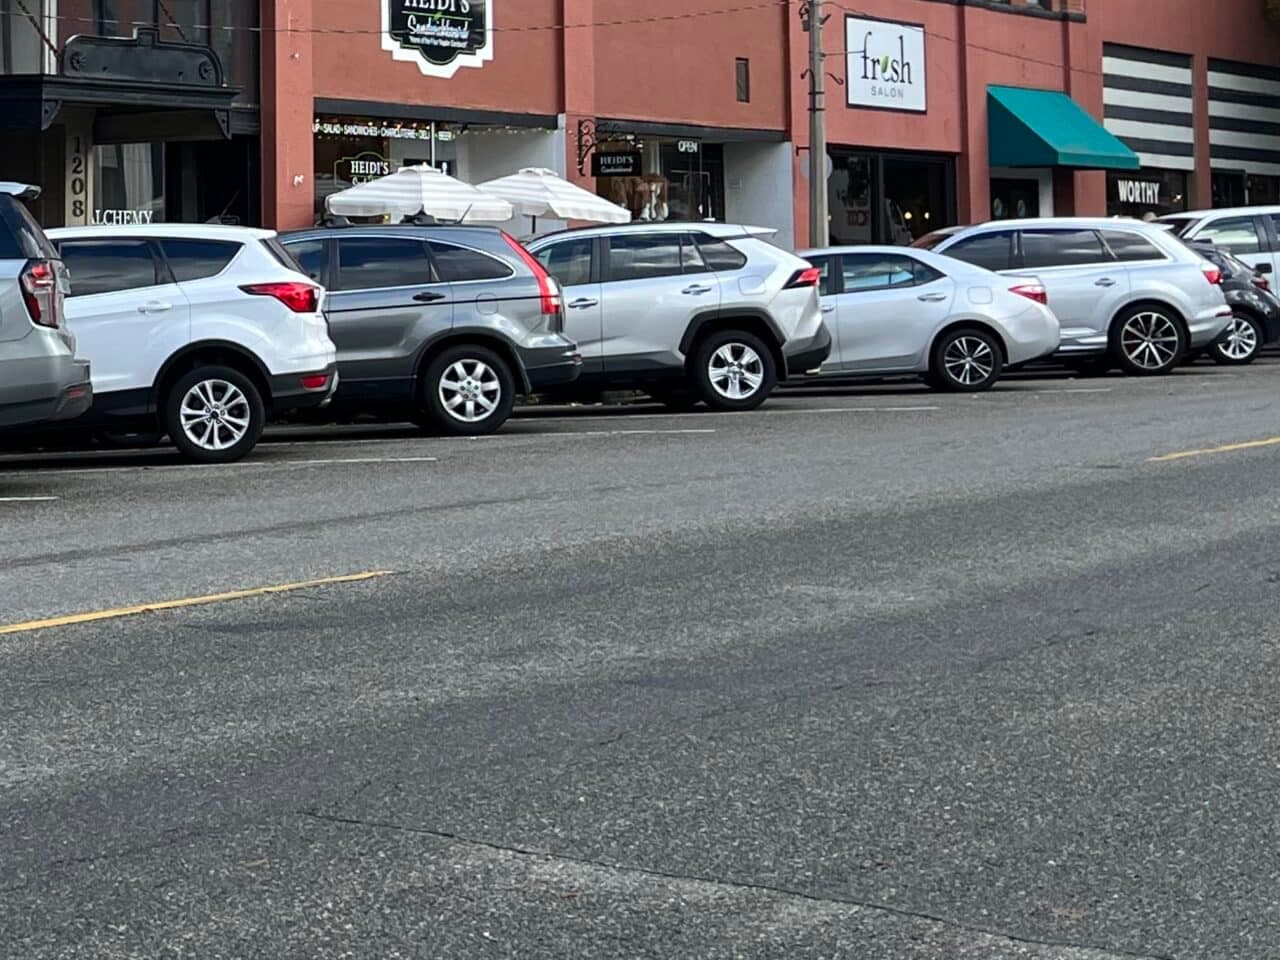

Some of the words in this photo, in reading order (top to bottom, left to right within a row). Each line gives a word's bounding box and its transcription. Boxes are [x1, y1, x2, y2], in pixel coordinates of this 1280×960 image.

[861, 31, 913, 85] fresh
[871, 86, 905, 99] SALON
[677, 140, 699, 152] OPEN
[71, 136, 84, 218] 1208
[350, 160, 390, 175] HEIDI'S
[1117, 180, 1160, 205] WORTHY
